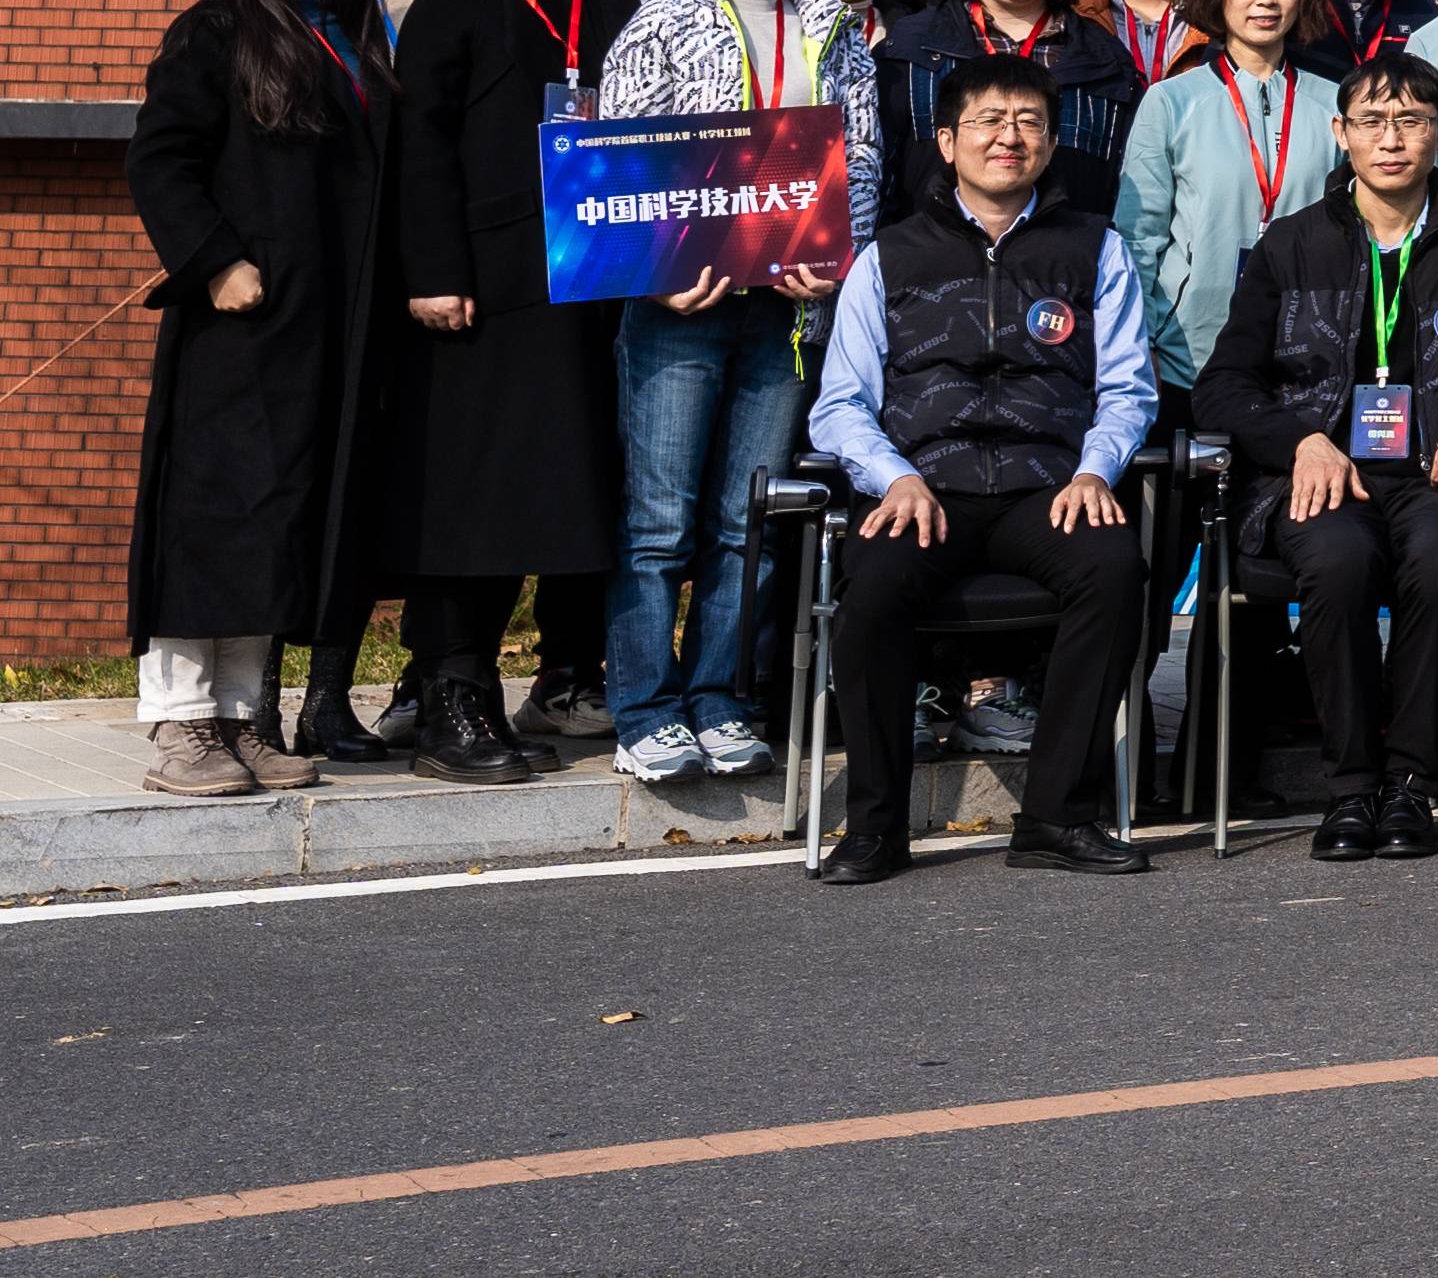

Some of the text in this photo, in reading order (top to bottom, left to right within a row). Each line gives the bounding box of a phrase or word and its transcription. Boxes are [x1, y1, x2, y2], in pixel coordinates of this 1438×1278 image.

[576, 180, 818, 227] 中国科学技术大学
[1036, 310, 1066, 332] FH
